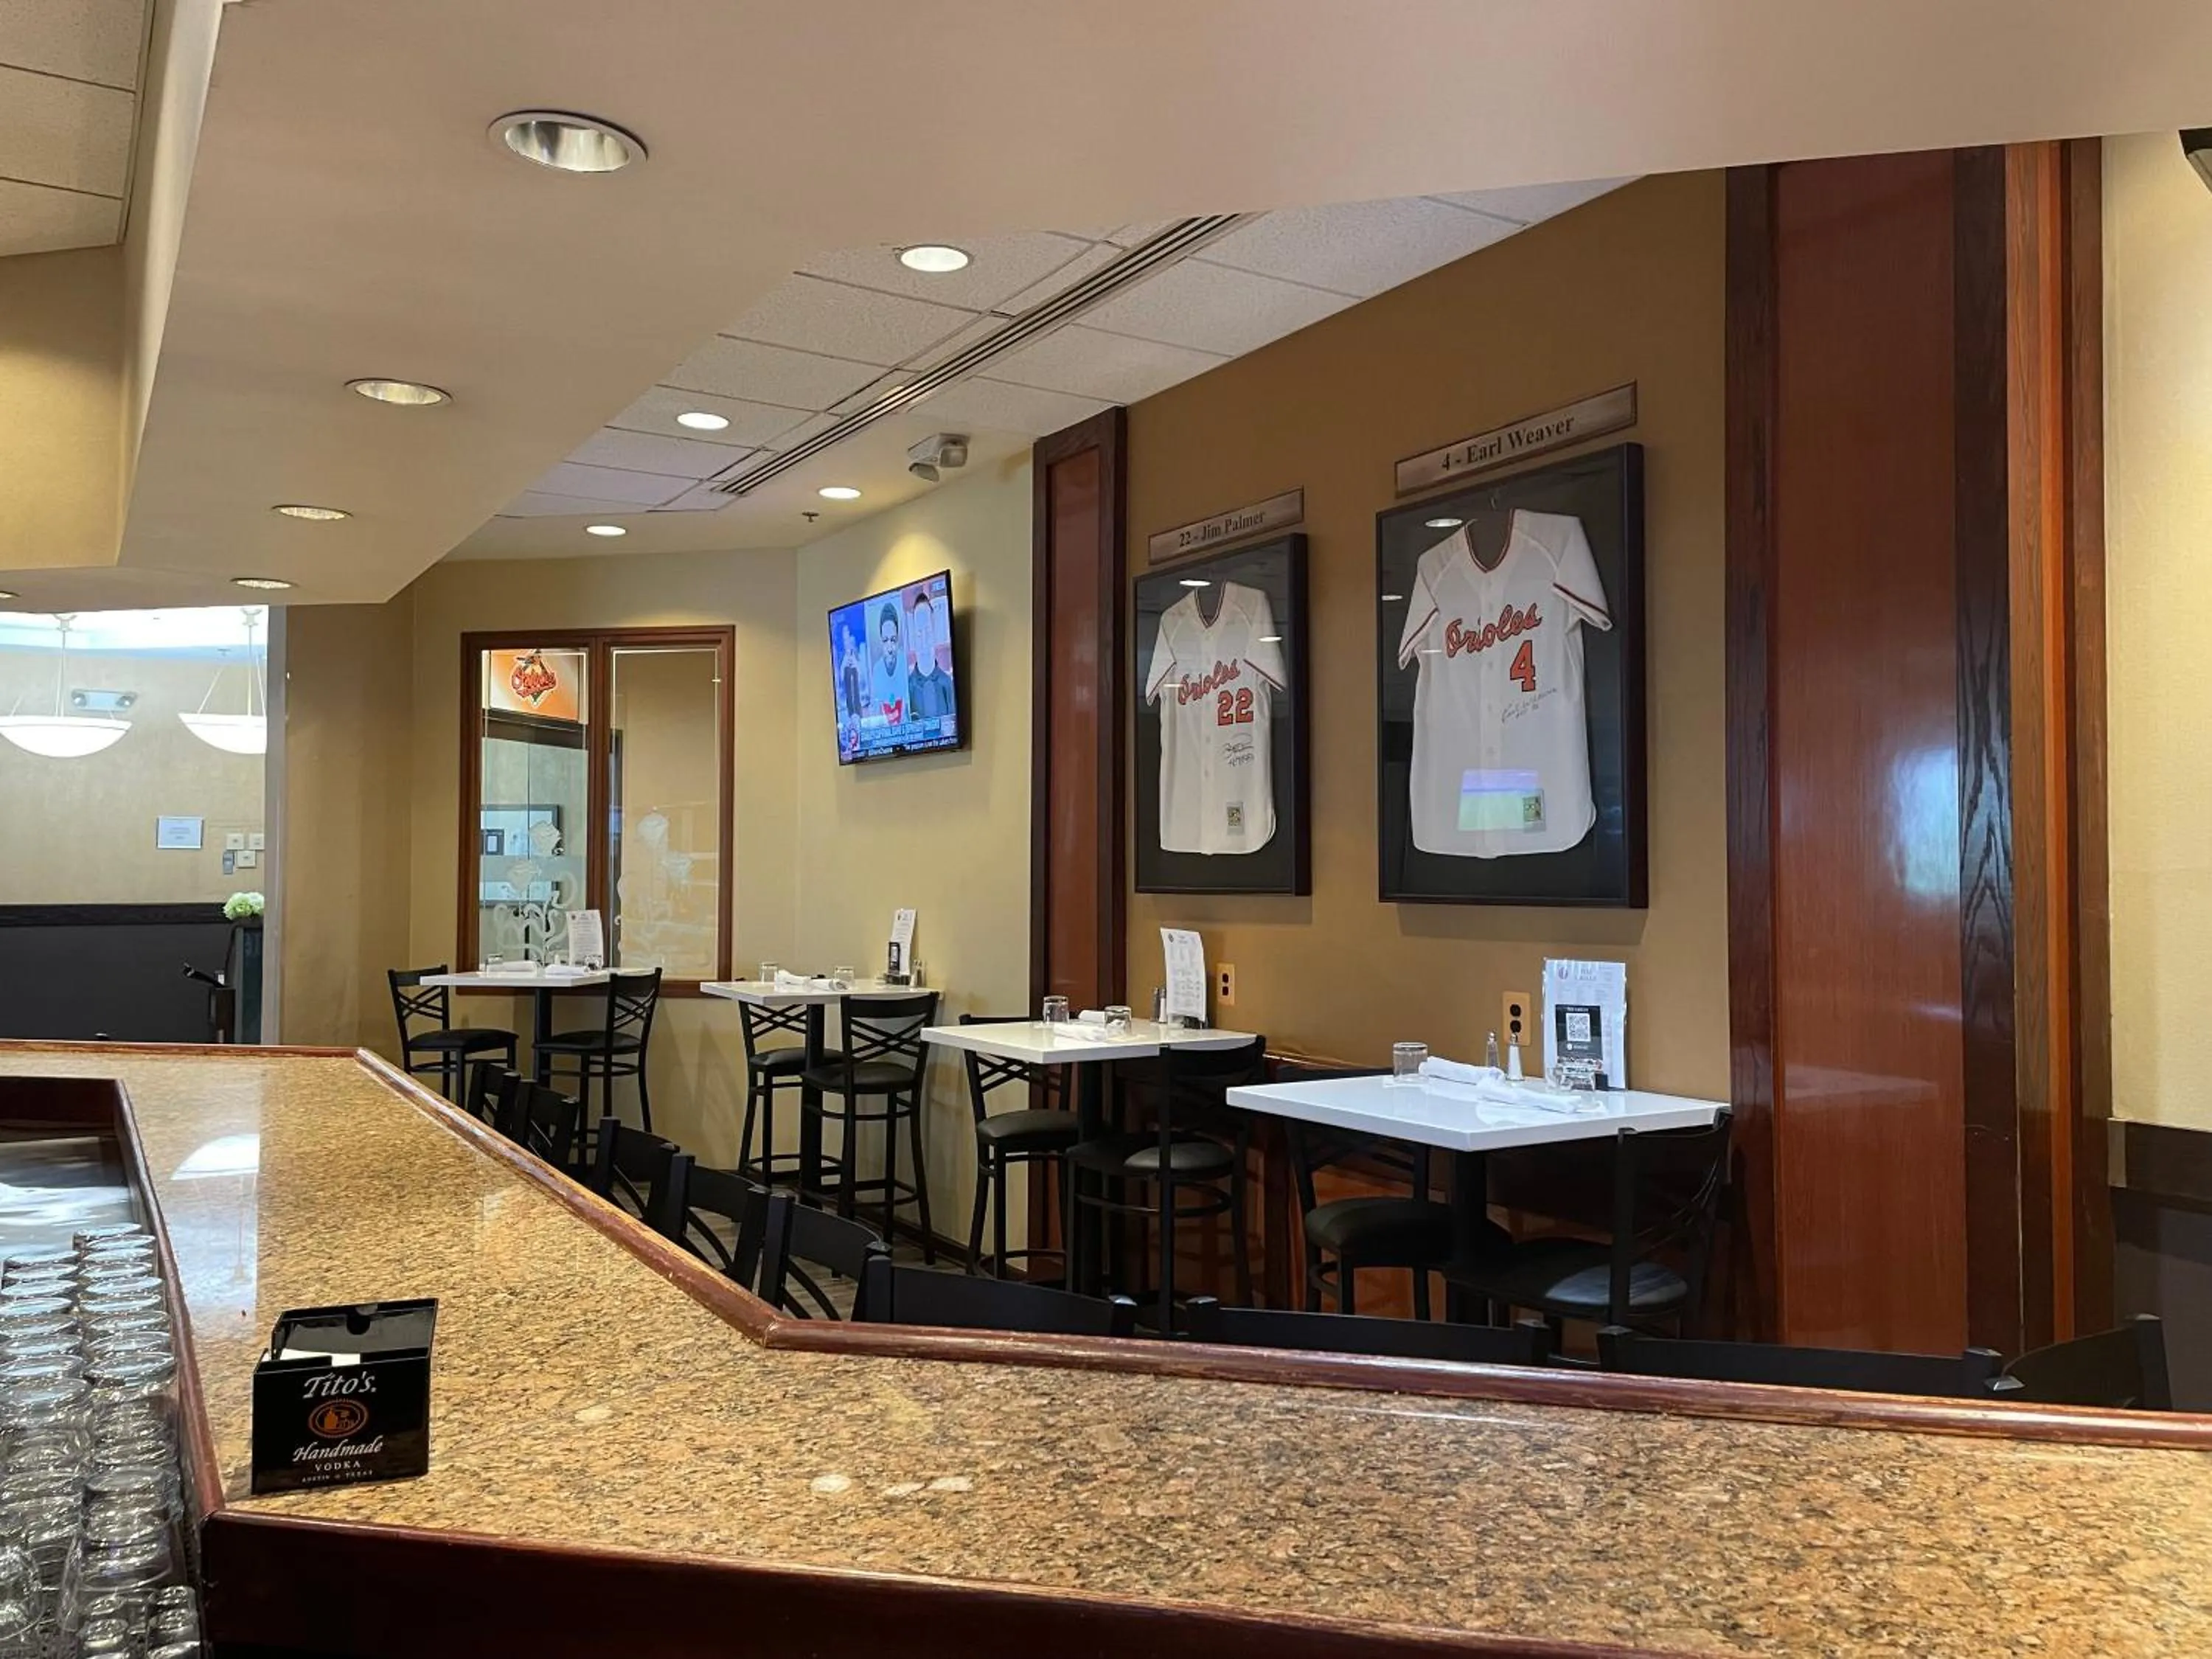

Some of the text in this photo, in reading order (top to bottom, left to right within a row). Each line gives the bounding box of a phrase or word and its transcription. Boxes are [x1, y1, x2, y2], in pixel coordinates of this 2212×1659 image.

[1441, 453, 1451, 471] 4
[1467, 437, 1502, 464] Earl
[1506, 417, 1575, 449] Weaver
[1180, 530, 1192, 547] 22
[1201, 524, 1221, 540] Jim
[1225, 512, 1265, 533] Palmer
[1445, 602, 1543, 658] Orioles
[1178, 658, 1240, 706] Orioles
[1509, 639, 1536, 692] 4
[1217, 687, 1253, 726] 22
[292, 1435, 383, 1462] Handmade
[315, 1461, 361, 1472] VODKA
